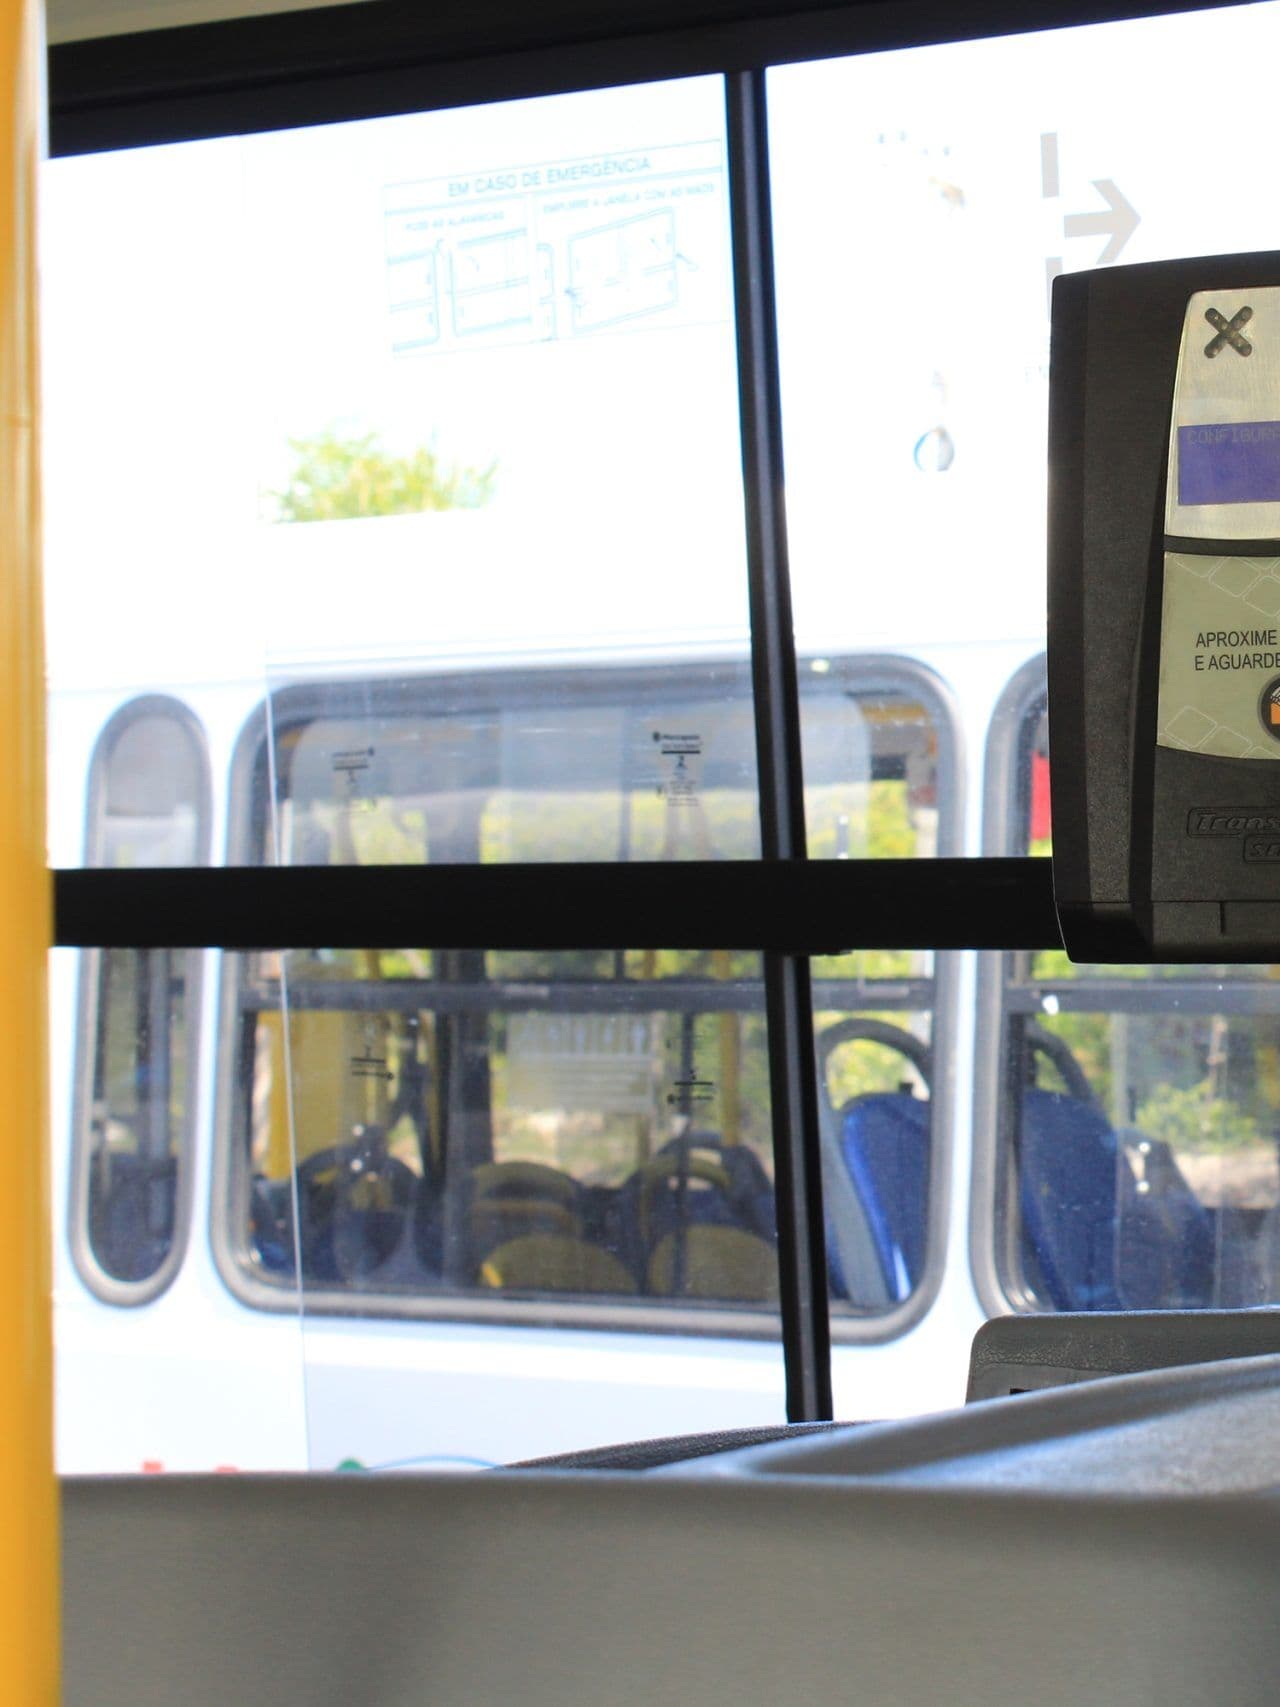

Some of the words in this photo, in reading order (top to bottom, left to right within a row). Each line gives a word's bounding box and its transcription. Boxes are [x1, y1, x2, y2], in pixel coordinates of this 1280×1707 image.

[448, 181, 470, 197] EM
[474, 173, 517, 193] CASO
[521, 170, 541, 187] DE
[546, 156, 651, 184] EMERGÊNCIA
[1195, 629, 1277, 648] APROXIME
[1195, 655, 1204, 671] E
